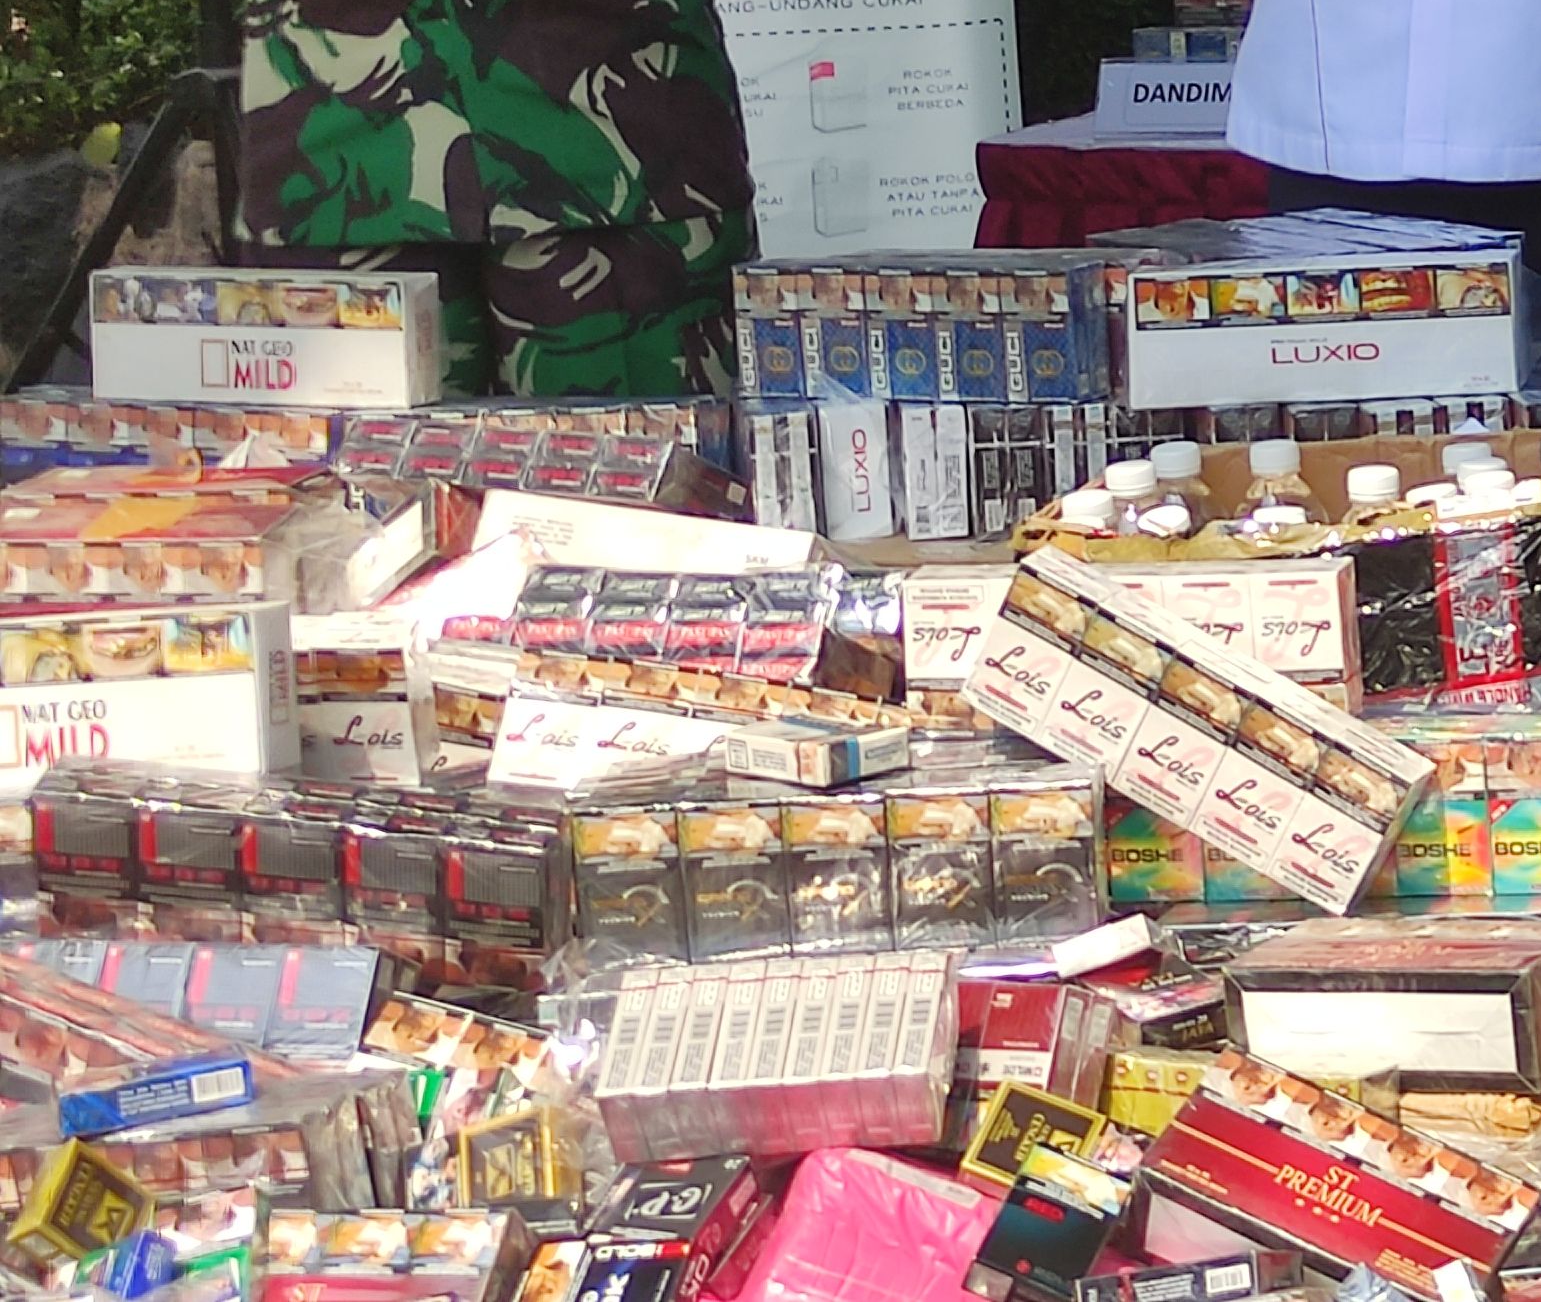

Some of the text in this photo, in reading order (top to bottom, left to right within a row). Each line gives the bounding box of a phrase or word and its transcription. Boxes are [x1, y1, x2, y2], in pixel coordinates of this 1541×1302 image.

[230, 339, 257, 358] NAT
[1270, 341, 1380, 365] LUXIO
[233, 361, 297, 391] MILD
[851, 428, 872, 513] LUXIO
[1111, 846, 1184, 865] BOSHE
[1399, 841, 1472, 860] BOSHE
[1323, 1165, 1360, 1189] ST
[1274, 1163, 1384, 1229] PREMIUM
